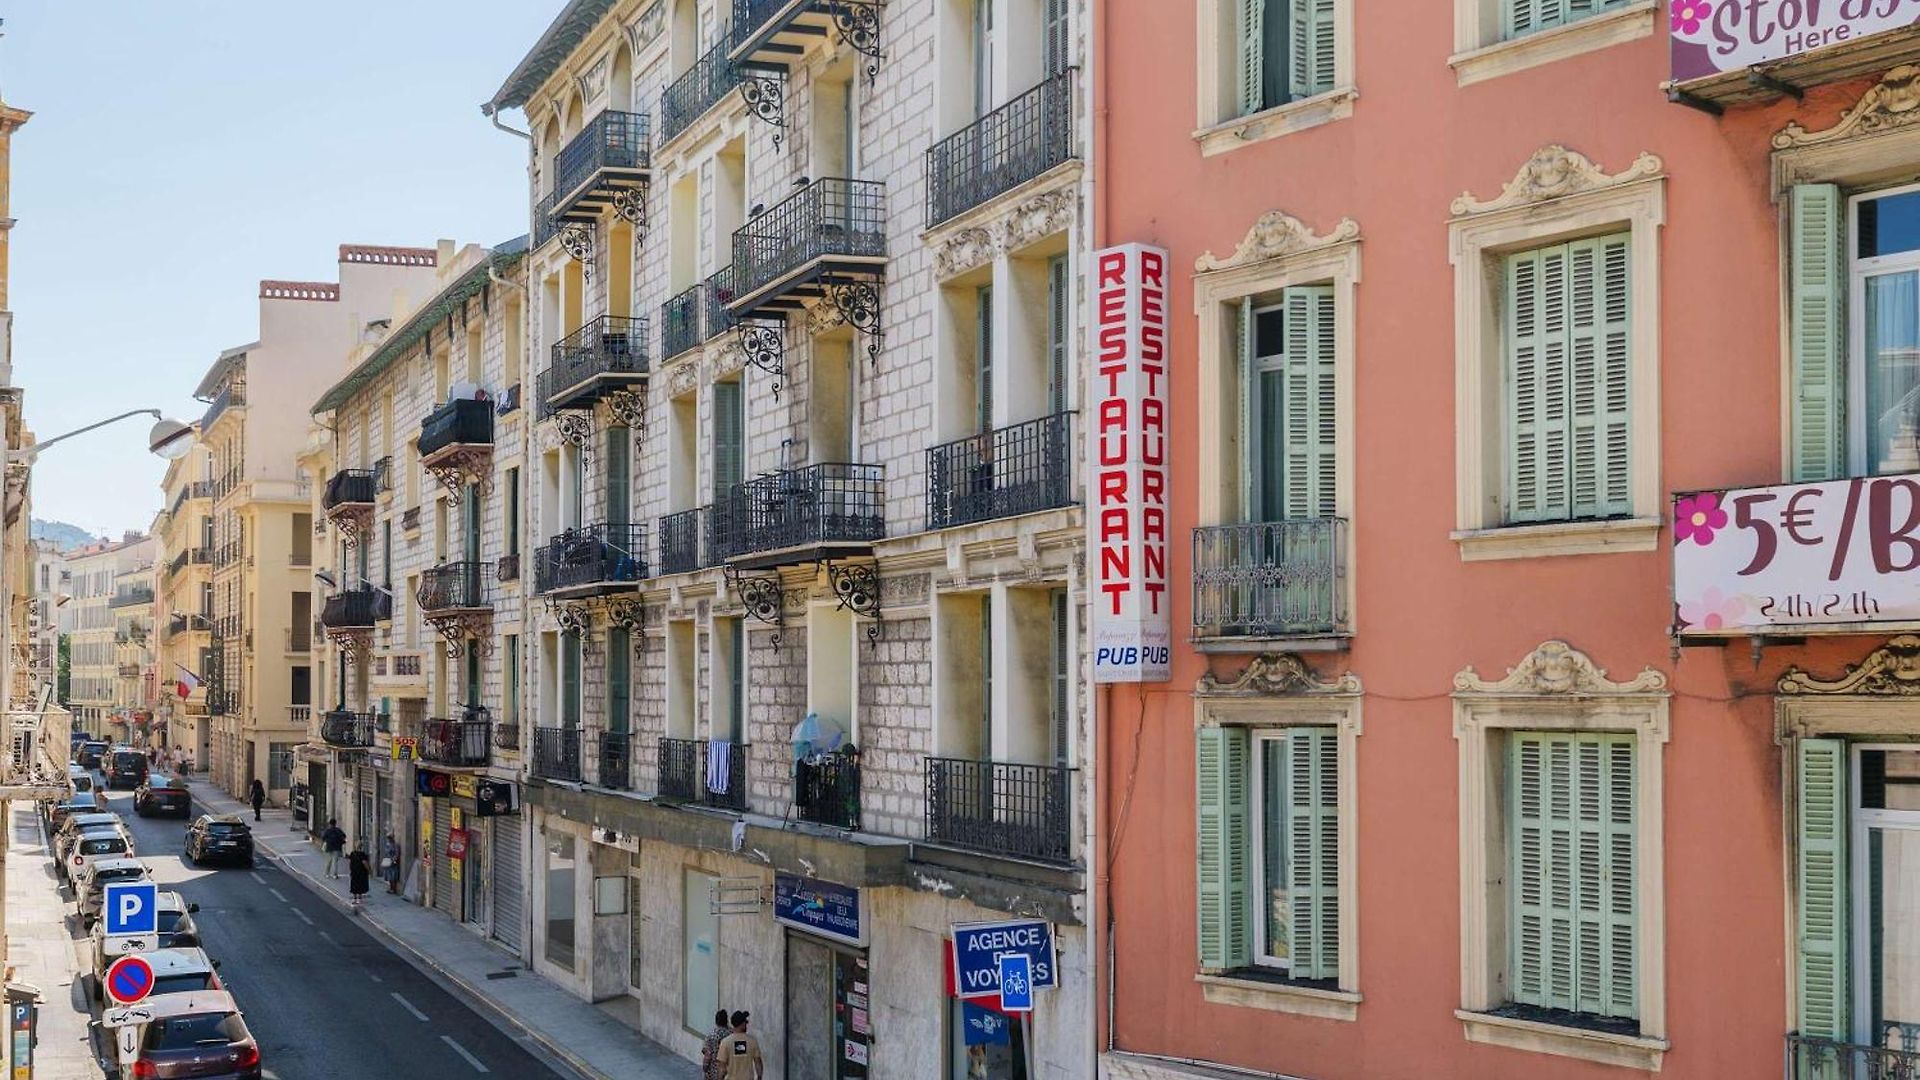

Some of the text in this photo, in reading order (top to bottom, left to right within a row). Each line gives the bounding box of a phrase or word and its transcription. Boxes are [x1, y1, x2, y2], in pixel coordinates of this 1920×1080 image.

[1785, 23, 1850, 54] Here
[1099, 252, 1131, 615] RESTAURANT
[1141, 251, 1165, 614] RESTAURANT
[1097, 647, 1138, 665] PUB
[1142, 646, 1169, 664] PUB
[120, 894, 143, 925] P
[968, 928, 1040, 951] AGENCE
[993, 950, 1017, 965] D
[16, 1006, 25, 1019] P
